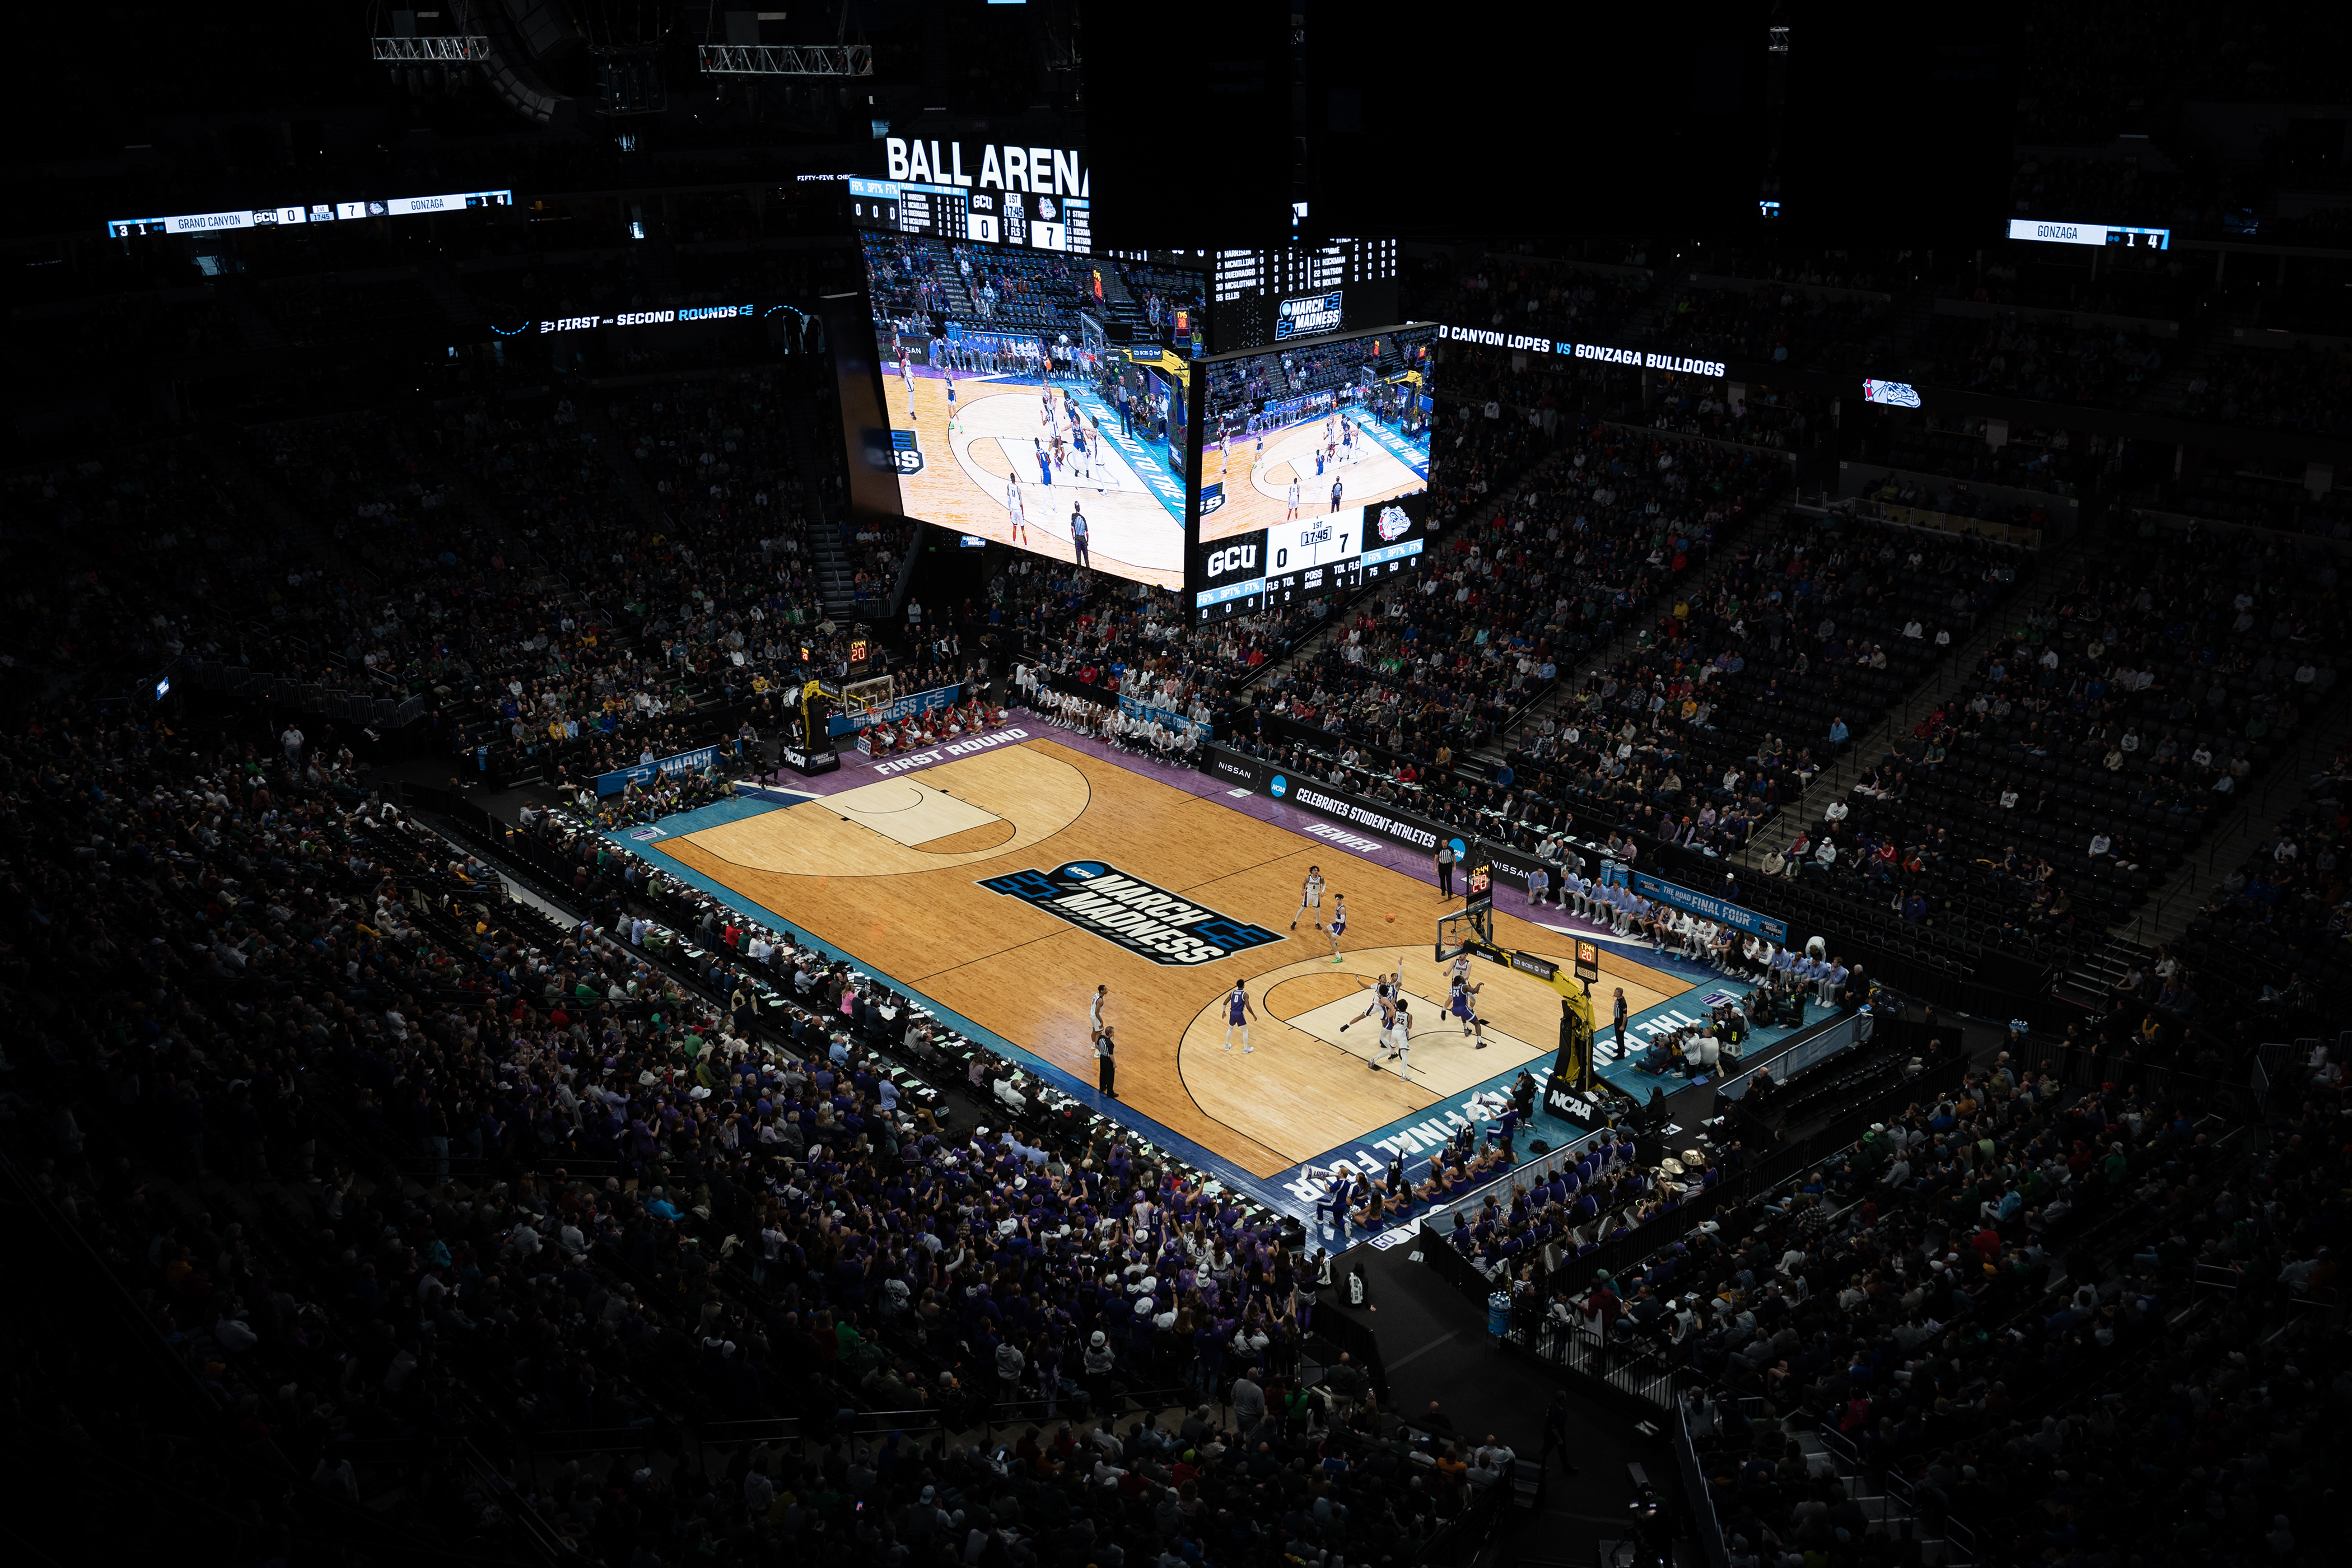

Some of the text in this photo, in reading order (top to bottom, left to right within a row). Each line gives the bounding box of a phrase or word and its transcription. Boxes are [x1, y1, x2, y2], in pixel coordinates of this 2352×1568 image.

[886, 138, 972, 186] BALL
[851, 180, 898, 195] FG% 3PT% FT%
[410, 198, 444, 211] GONZAGA
[481, 195, 504, 207] 1 4
[973, 195, 992, 210] GCU
[1009, 194, 1018, 203] 1ST
[253, 212, 277, 223] GCU
[287, 210, 295, 221] 0
[348, 206, 355, 216] 7
[855, 203, 895, 220] 0 0 0
[1005, 206, 1023, 218] 17:45
[178, 215, 240, 229] GRAND CANYON
[1010, 218, 1020, 227] TOL
[1072, 219, 1088, 228] TIMME
[119, 224, 147, 236] 3 1
[981, 220, 988, 239] 0
[1011, 227, 1020, 236] FLS
[1047, 227, 1053, 246] 7
[2037, 225, 2078, 239] GONZAGA
[1009, 236, 1023, 245] BONUS
[1074, 237, 1091, 245] WATSON
[2127, 234, 2157, 248] 1 4
[1074, 245, 1090, 254] BOLTON
[1224, 258, 1255, 269] MCMILLIAN
[1322, 256, 1346, 266] HICKMAN
[1322, 267, 1343, 277] WATSON
[1225, 278, 1256, 290] MCGLOTHAN
[1322, 277, 1341, 287] BOLTON
[1225, 291, 1240, 301] ELLIS
[1291, 298, 1324, 316] MARCH
[557, 316, 600, 331] FIRST
[617, 310, 674, 325] SECOND
[678, 306, 737, 321] ROUNDS
[1295, 310, 1340, 329] MADNESS
[1451, 326, 1725, 377] CANYON LOPES VS GONZAGA BULLDOGS
[1313, 521, 1323, 530] 1ST
[1305, 529, 1328, 544] 17:45
[1340, 533, 1348, 553] 7
[1277, 548, 1287, 568] 0
[1368, 543, 1422, 562] FG% 3PT% FT%
[1207, 545, 1257, 577] GCU
[1334, 561, 1360, 575] TOL FLS
[1369, 557, 1416, 577] 75 50 0
[1305, 569, 1323, 581] POSS
[1336, 575, 1355, 587] 4 1
[1266, 576, 1295, 592] FLS TOL
[1305, 579, 1322, 589] BONUS
[1198, 581, 1259, 604] FG% 3PT% FT%
[1270, 591, 1290, 605] 1 3
[1202, 598, 1254, 618] 0 0 0
[851, 640, 866, 650] 17:44
[851, 647, 865, 661] 20
[853, 698, 917, 728] MNESS
[858, 739, 871, 754] DEFENSE
[873, 729, 1029, 775] FIRST ROUND
[659, 750, 712, 777] MARCH
[786, 750, 806, 768] NCAA
[817, 756, 834, 765] MADNESS
[1219, 761, 1251, 779] NISSAN
[1271, 784, 1286, 794] NCAA
[1296, 787, 1437, 849] CELEBRATES STUDENT-ATHLETES
[1303, 823, 1383, 853] DENVER
[1452, 849, 1464, 858] CAA
[1067, 866, 1096, 879] NCAA
[1473, 864, 1489, 877] 17:44
[1472, 874, 1487, 893] 20
[1079, 874, 1214, 926] MARCH
[1663, 885, 1691, 902] THE ROAD
[1691, 895, 1751, 927] FINAL FOUR
[1052, 892, 1225, 963] MADNESS
[1765, 925, 1782, 935] MADNESS
[1581, 942, 1594, 953] 17:44
[1476, 950, 1494, 962] SPALDING
[1581, 950, 1592, 962] 20
[1453, 989, 1459, 997] 24
[1635, 1010, 1702, 1035] THE
[1549, 1089, 1592, 1121] NCAA
[1151, 1216, 1159, 1225] 11
[1371, 1234, 1397, 1249] GO
